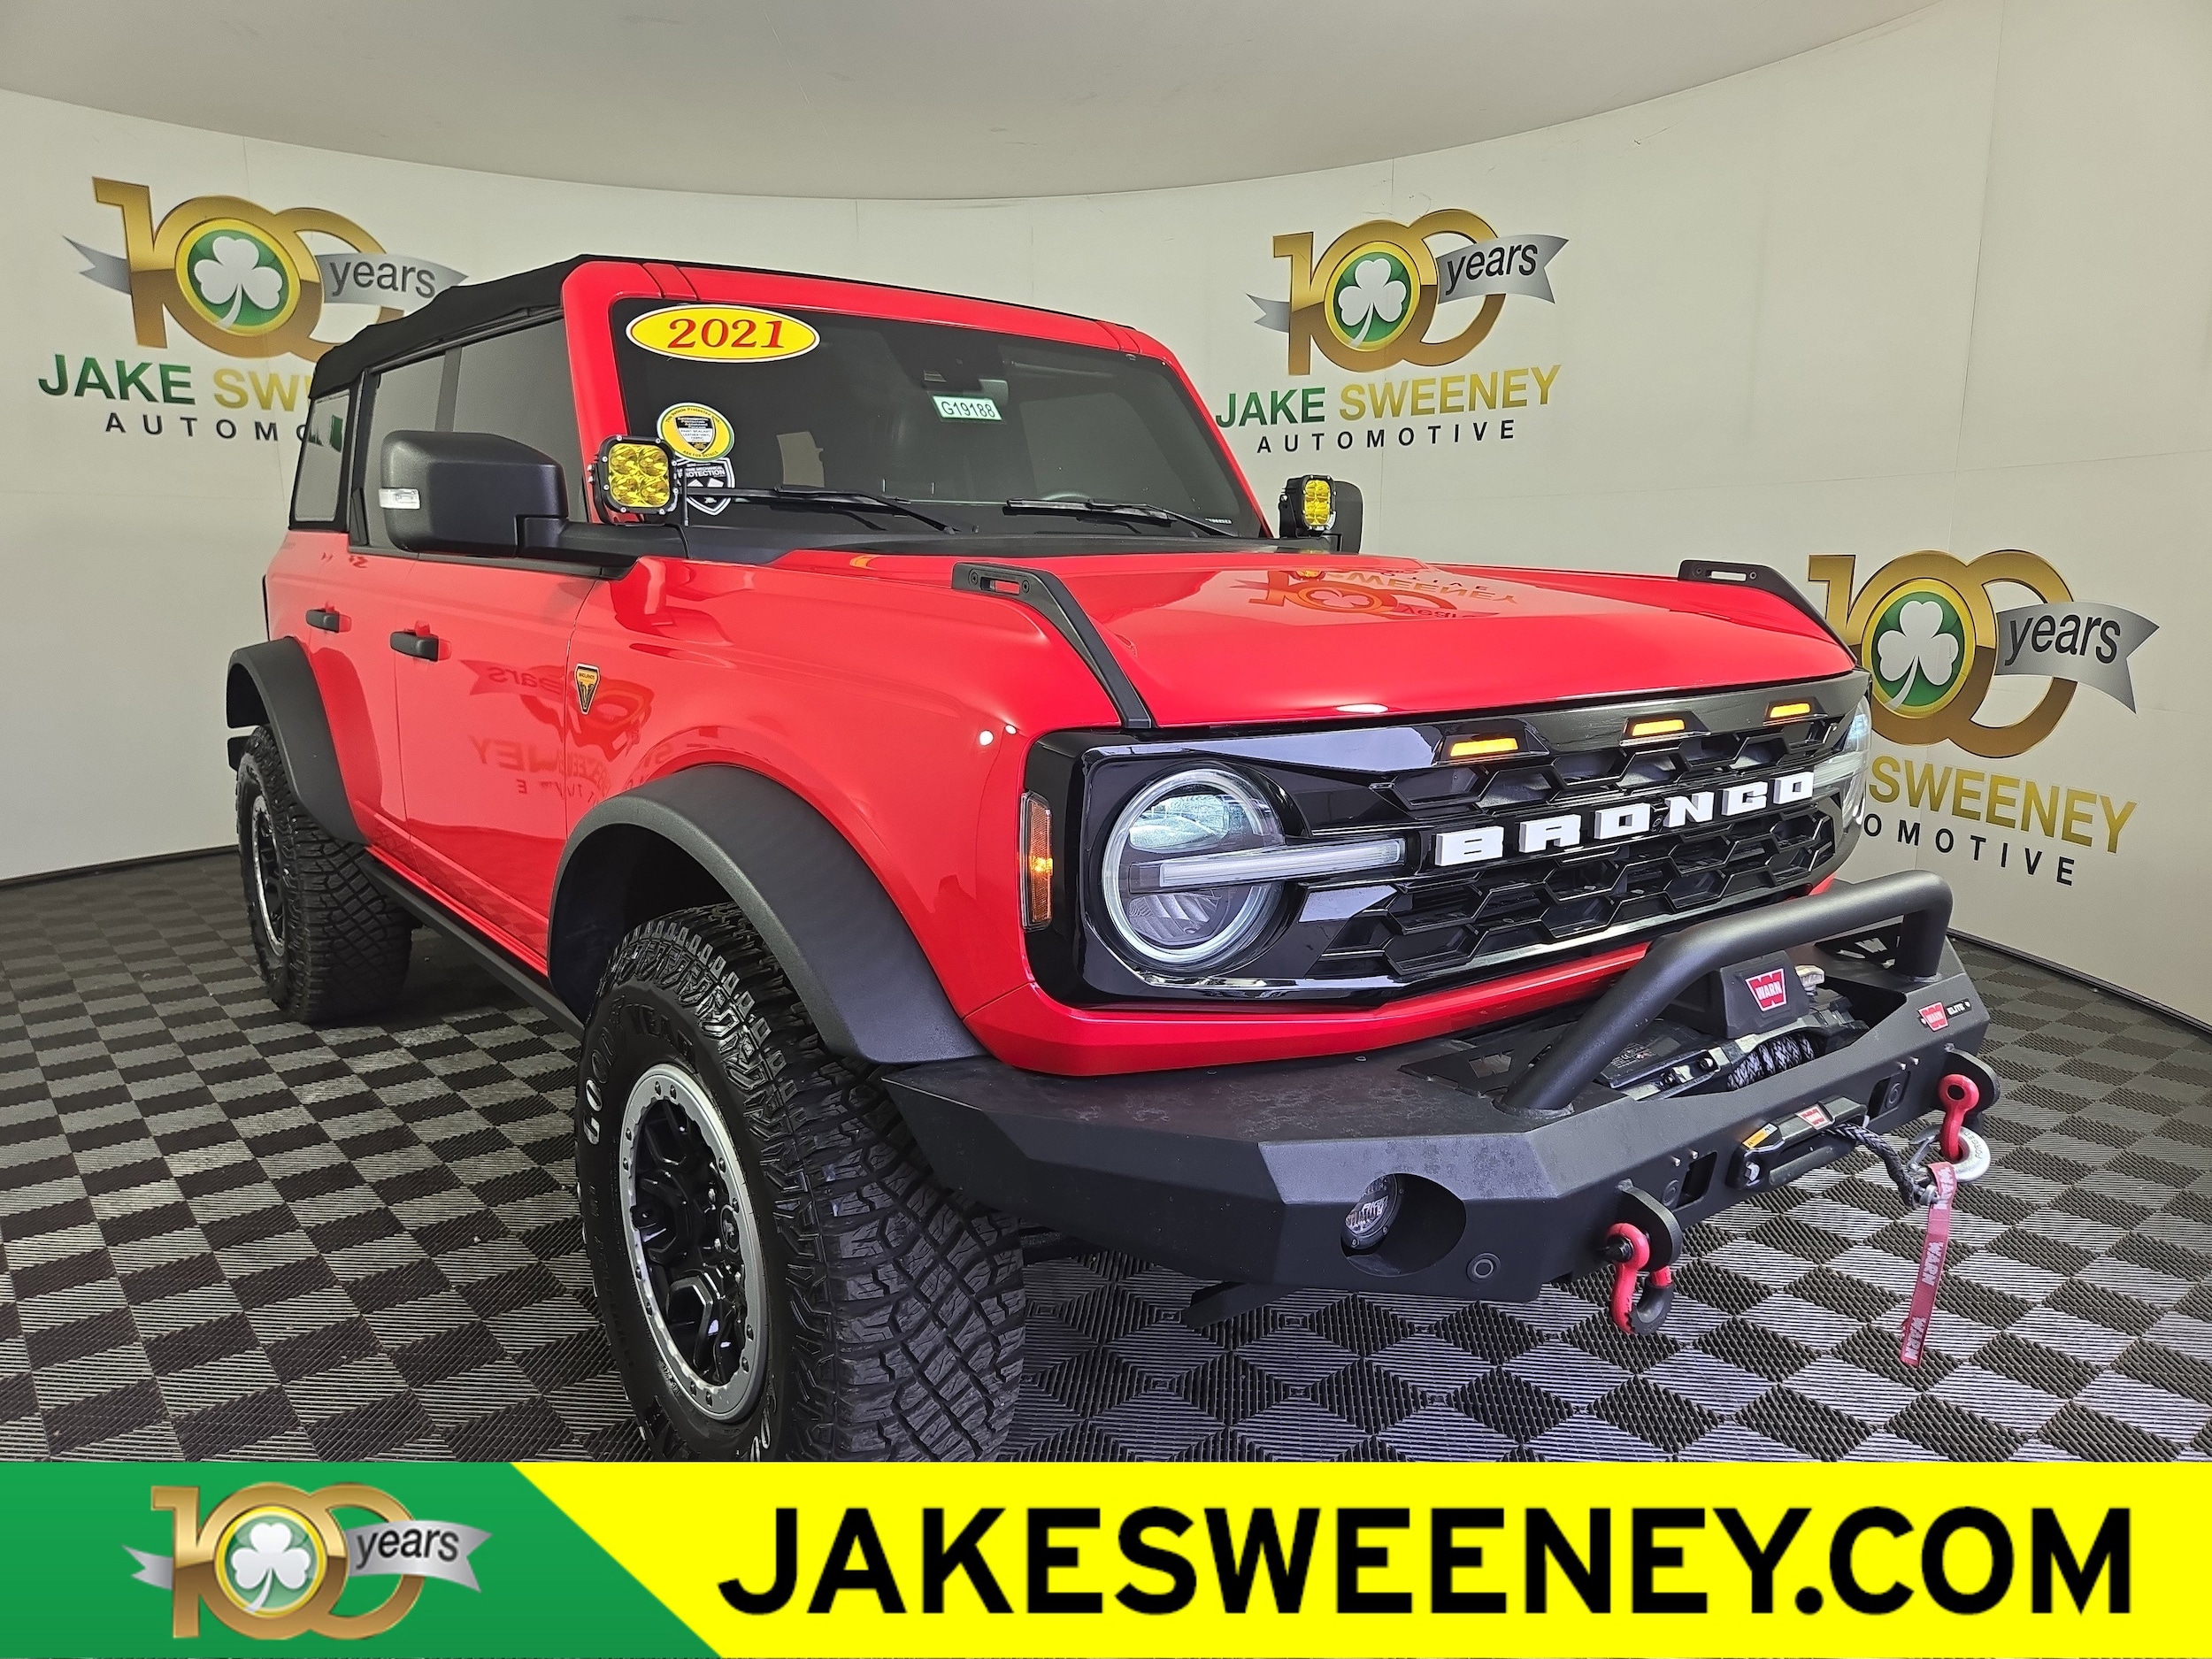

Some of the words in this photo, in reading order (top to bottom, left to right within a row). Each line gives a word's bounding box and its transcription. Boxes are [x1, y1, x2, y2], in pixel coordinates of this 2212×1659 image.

[328, 256, 436, 298] years
[1445, 240, 1540, 296] years
[1273, 209, 1507, 376] 100
[667, 318, 785, 349] 2021
[38, 354, 196, 405] JAKE
[1216, 387, 1326, 428] JAKE
[1340, 365, 1562, 422] SWEENEY
[941, 401, 995, 418] G19188
[1256, 419, 1516, 454] AUTOMOTIVE
[1809, 549, 2079, 758] 100
[2004, 613, 2122, 667] years
[1435, 771, 1815, 866] BRONCO
[1869, 755, 2138, 855] SWEENEY
[1755, 980, 1783, 1001] WARN
[1947, 1002, 1965, 1016] ELITE
[1921, 1241, 1944, 1286] WARN
[1904, 1317, 1927, 1361] WARN
